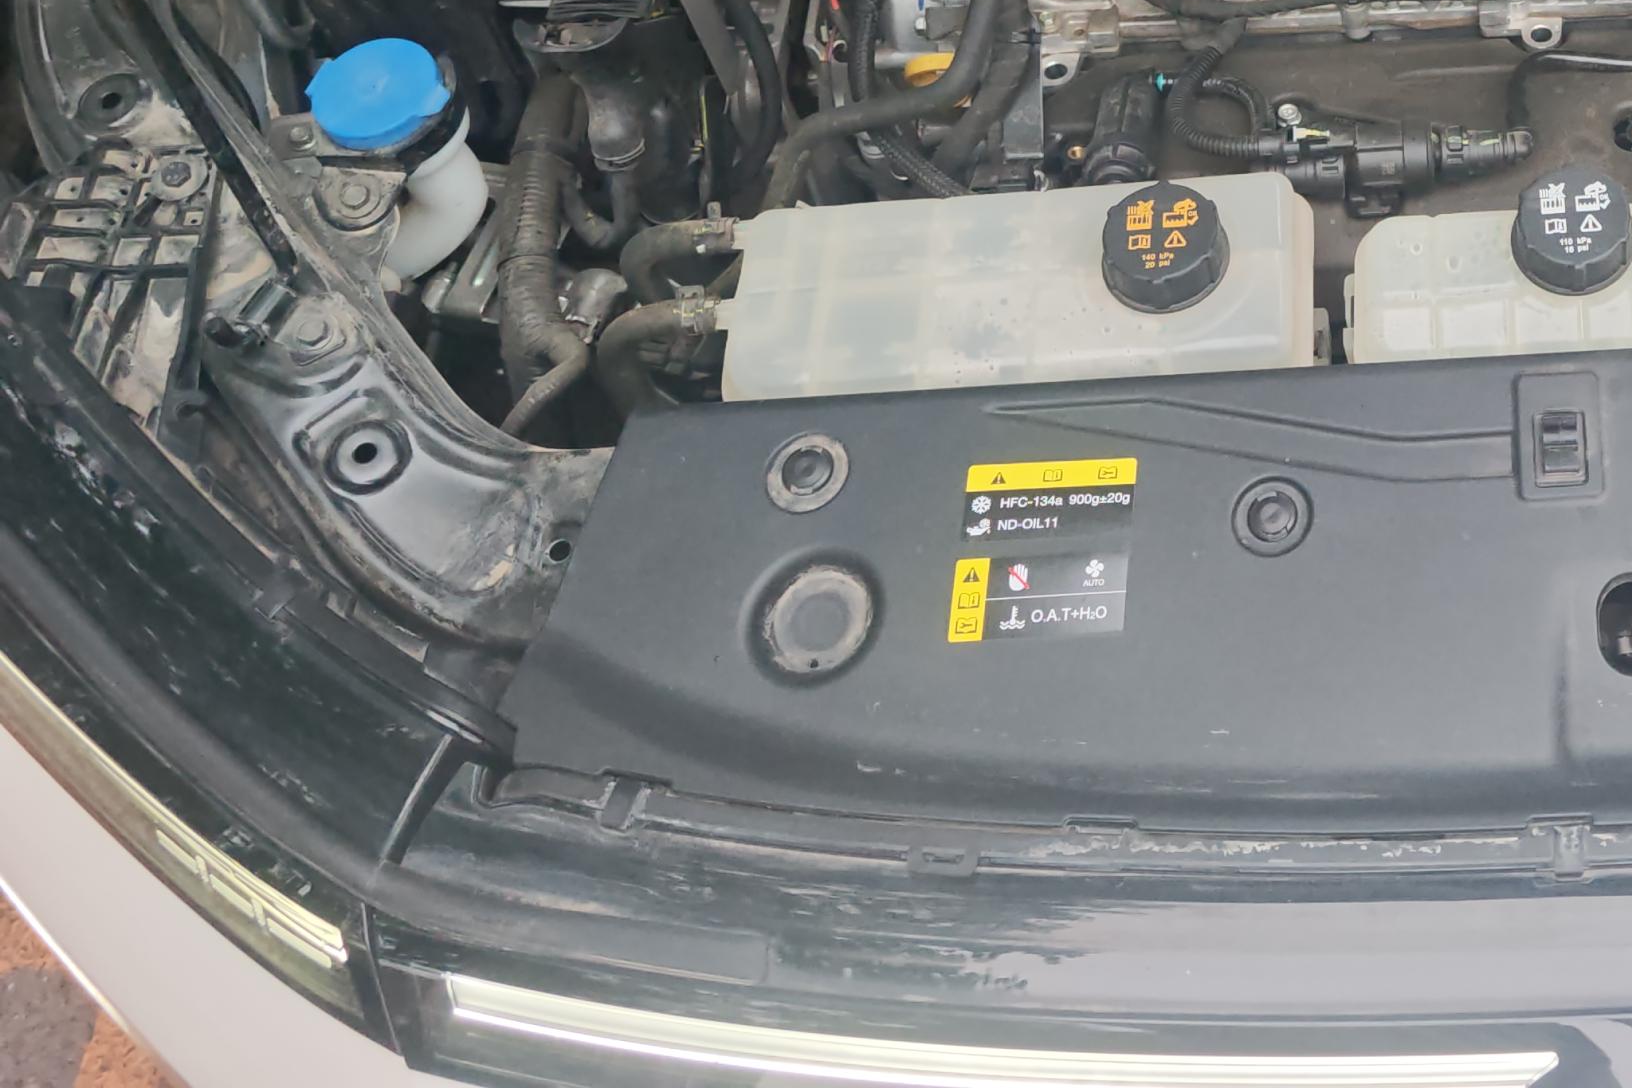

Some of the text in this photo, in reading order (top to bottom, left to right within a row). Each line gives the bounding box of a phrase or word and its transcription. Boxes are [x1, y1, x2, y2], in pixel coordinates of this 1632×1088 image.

[1000, 493, 1131, 509] HFC-134a 900g±20g
[997, 517, 1058, 531] ND-OIL11
[1083, 578, 1105, 587] AUTO
